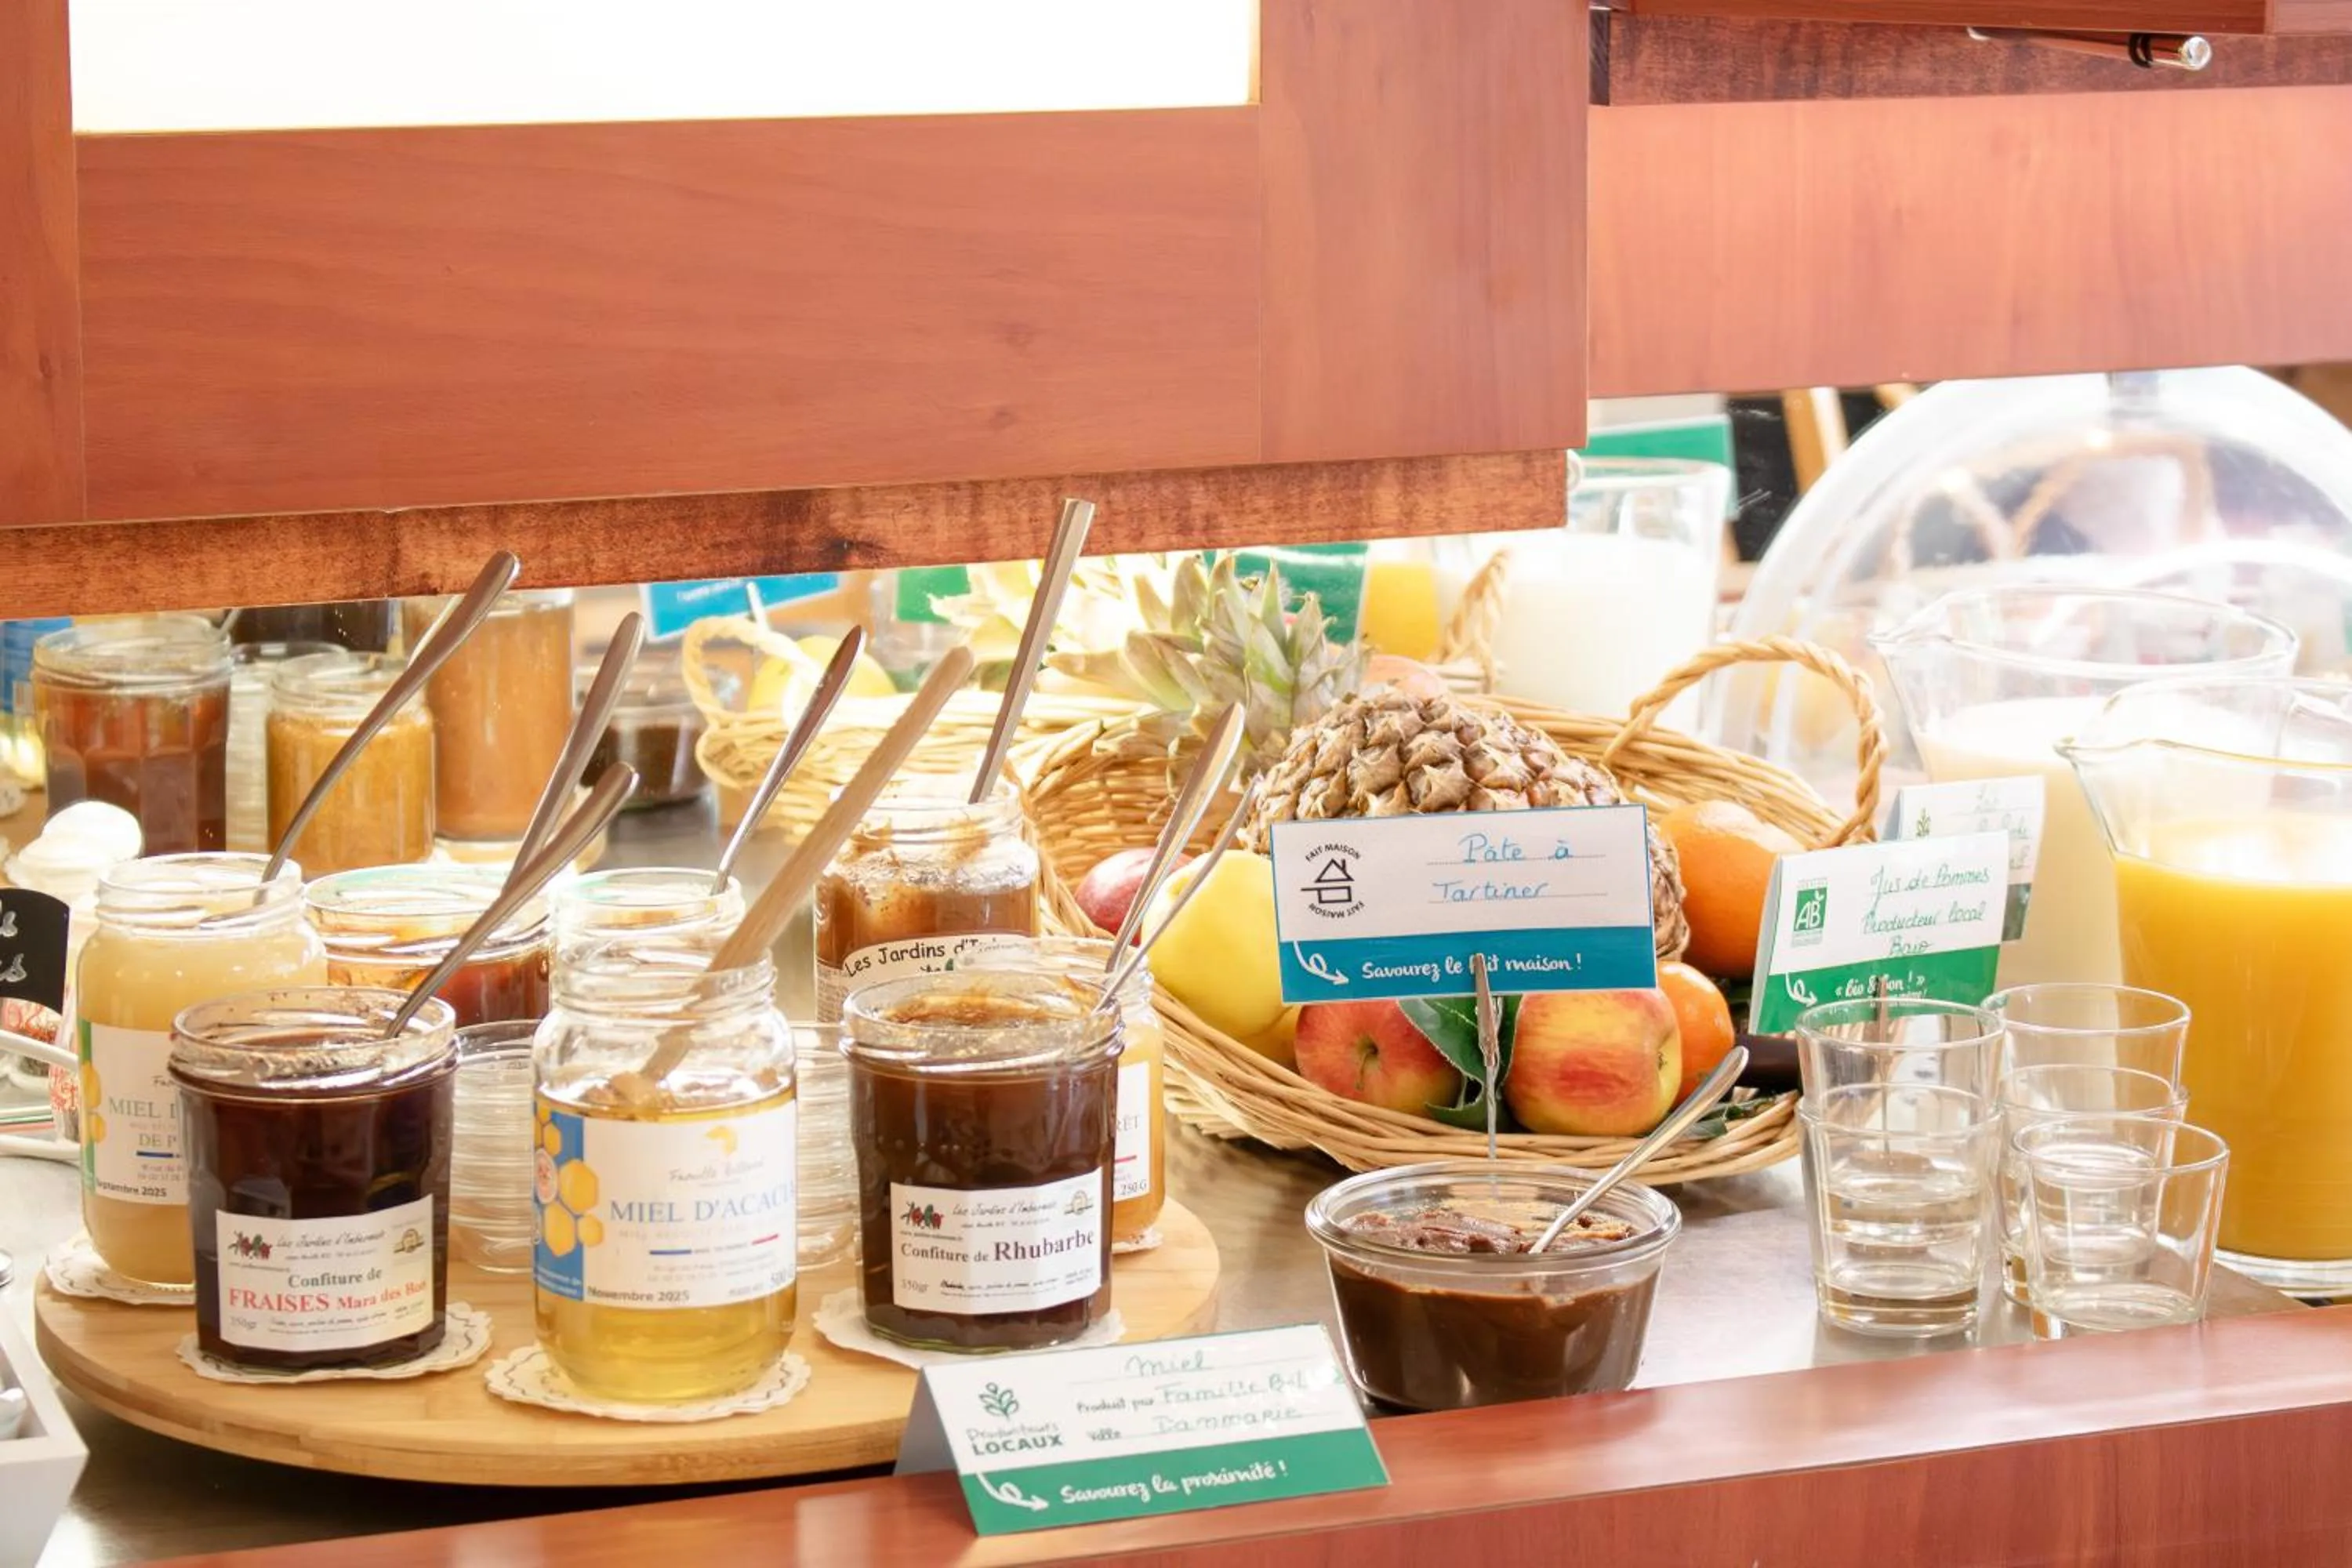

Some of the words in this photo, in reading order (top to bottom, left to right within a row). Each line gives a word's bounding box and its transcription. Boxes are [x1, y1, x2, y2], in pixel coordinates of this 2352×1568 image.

[1305, 845, 1323, 862] FAIT
[1325, 844, 1361, 859] MAISON
[1433, 880, 1548, 902] Tartiner
[1308, 903, 1345, 918] MAISON
[1347, 901, 1365, 916] FAIT
[1795, 900, 1820, 929] AB
[844, 956, 871, 978] Les
[878, 943, 945, 965] Jardins
[1362, 961, 1440, 982] Savourez
[1445, 956, 1463, 975] le
[1469, 953, 1500, 973] fit
[1505, 956, 1571, 971] maison
[1845, 978, 1864, 998] bio
[108, 1098, 160, 1120] MIEL
[141, 1185, 167, 1198] 2025
[611, 1200, 684, 1224] MIEL
[901, 1242, 969, 1263] Confiture
[974, 1253, 989, 1263] de
[993, 1229, 1094, 1261] Rhubarbe
[288, 1271, 364, 1289] Confiture
[367, 1266, 383, 1282] de
[229, 1287, 330, 1313] FRAISES
[337, 1295, 377, 1311] Mara
[380, 1287, 401, 1302] des
[589, 1286, 654, 1303] Novembre
[657, 1289, 690, 1302] 2025
[1126, 1350, 1206, 1377] Miel
[1076, 1398, 1127, 1414] Produit
[966, 1422, 1060, 1442] Producteurs
[971, 1435, 1064, 1456] LOCAUX
[1060, 1481, 1151, 1504] Savourez
[1151, 1474, 1180, 1494] la
[1181, 1461, 1276, 1495] proximité
